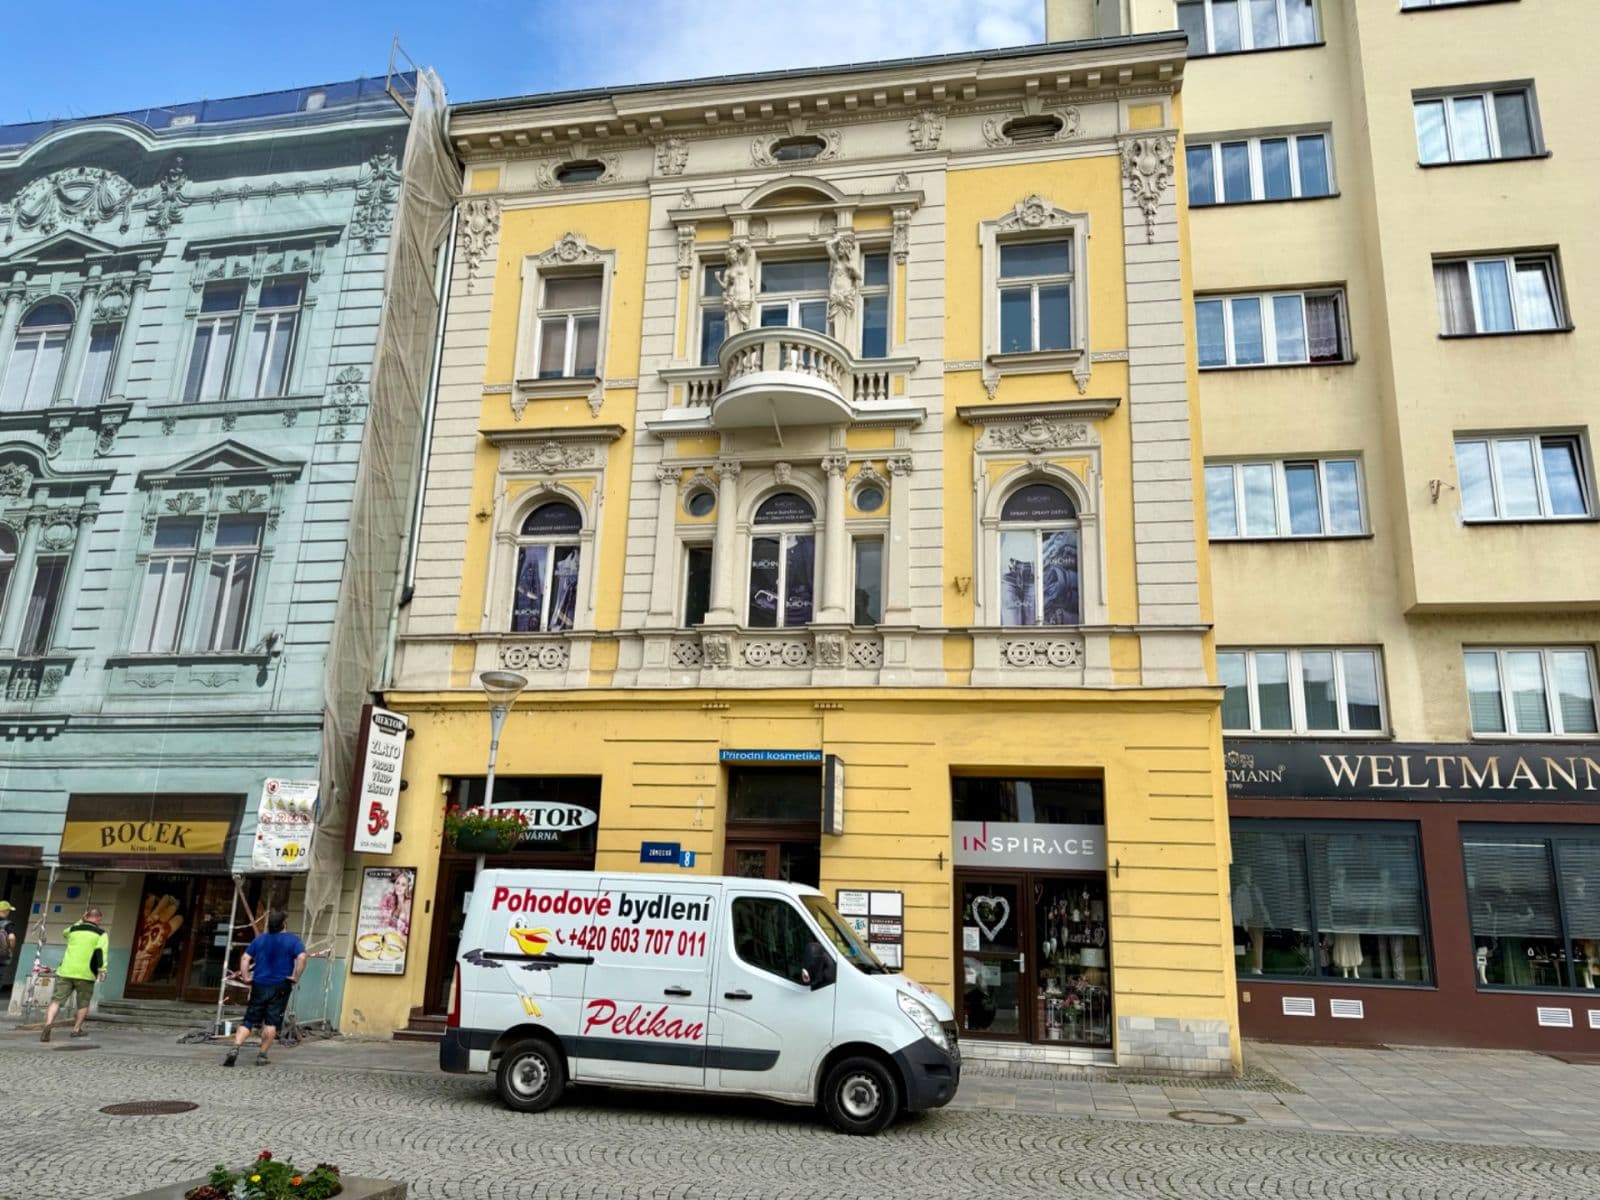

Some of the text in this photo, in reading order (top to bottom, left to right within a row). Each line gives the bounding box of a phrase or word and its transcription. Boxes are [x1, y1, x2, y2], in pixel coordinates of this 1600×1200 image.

[374, 714, 404, 730] HEKTOR
[371, 740, 401, 759] ZLATO
[767, 751, 821, 761] kosmetika
[1224, 769, 1282, 783] TMANN
[1320, 754, 1600, 790] WELTMANN
[367, 800, 390, 836] 5%
[962, 821, 1095, 855] INSPIRACE
[275, 847, 306, 857] TAIJO
[684, 851, 691, 867] 8
[491, 886, 711, 924] Pohodové bydlení
[569, 925, 706, 957] +420 603 707 011
[583, 998, 704, 1041] Pelikan
